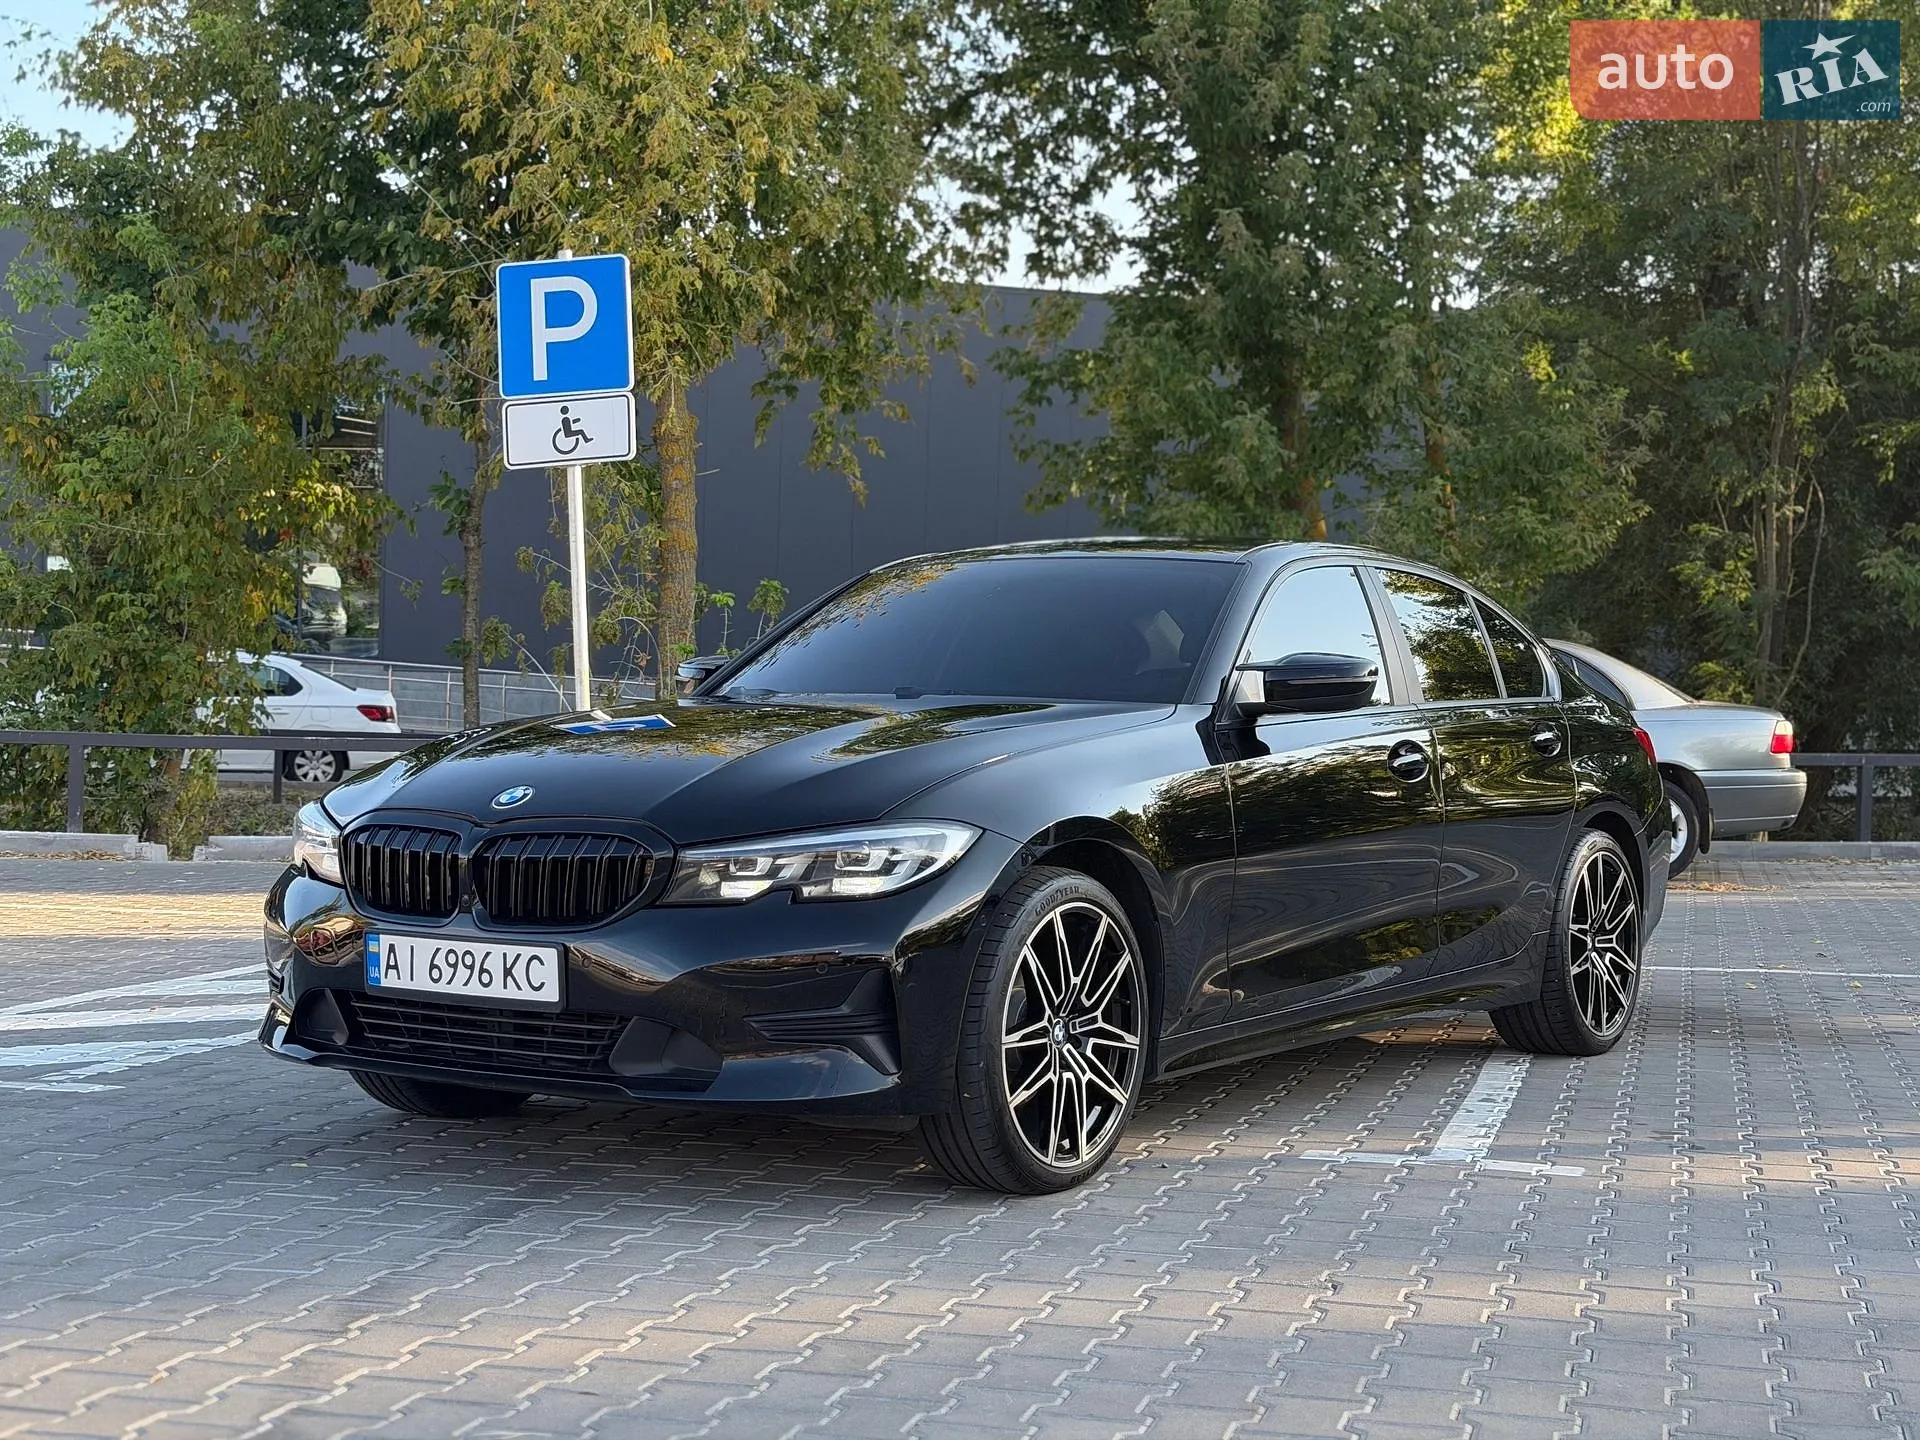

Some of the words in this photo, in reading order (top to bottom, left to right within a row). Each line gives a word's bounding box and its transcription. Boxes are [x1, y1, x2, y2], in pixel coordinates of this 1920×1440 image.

[530, 276, 598, 381] P
[1034, 885, 1081, 917] GOODYEAR
[369, 966, 380, 978] UA
[384, 943, 415, 982] AI
[428, 947, 494, 989] 6996
[502, 952, 546, 992] KC
